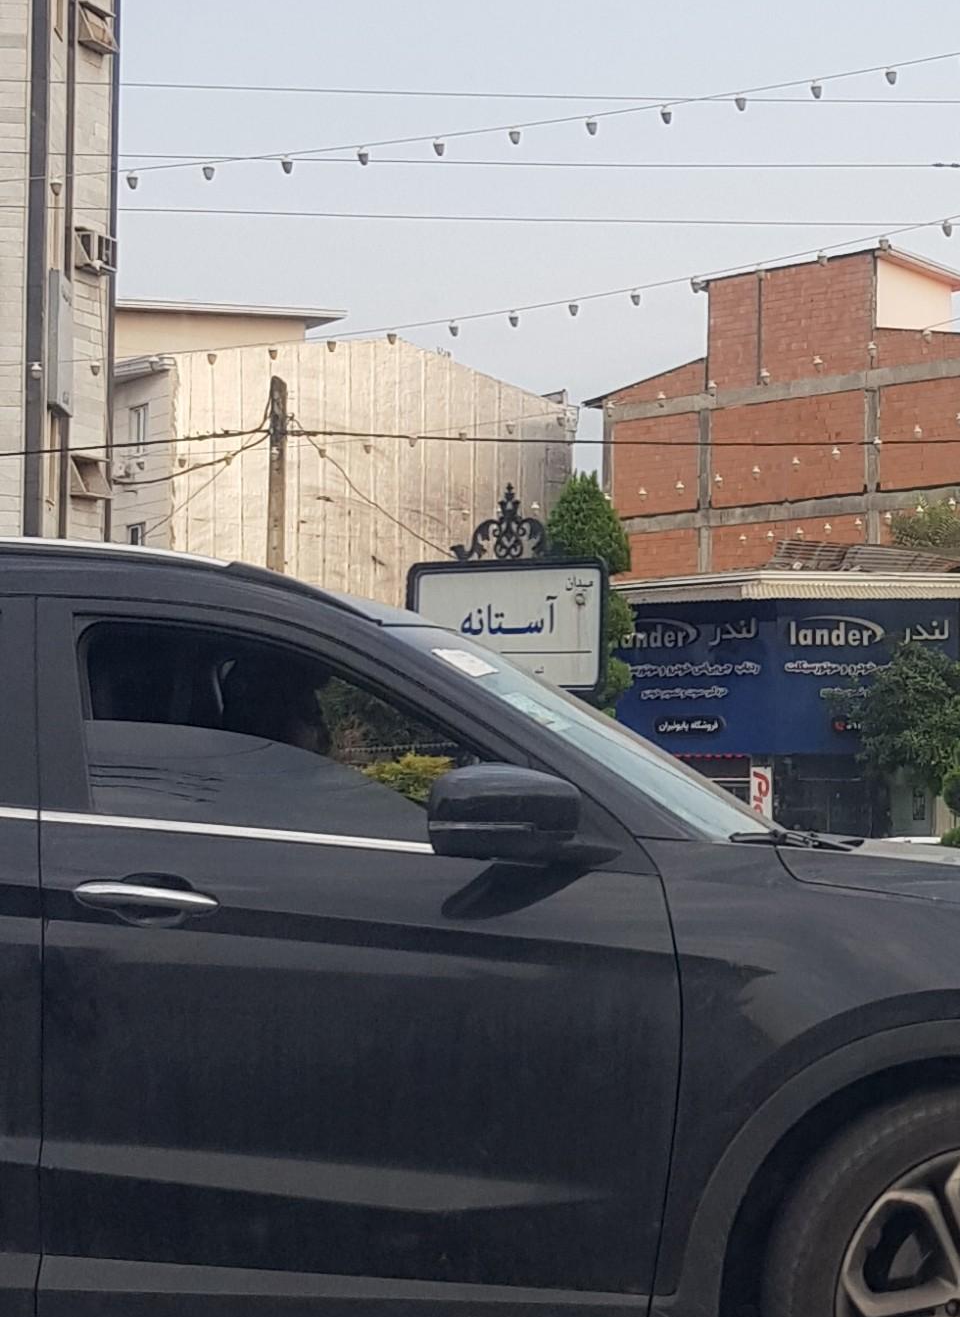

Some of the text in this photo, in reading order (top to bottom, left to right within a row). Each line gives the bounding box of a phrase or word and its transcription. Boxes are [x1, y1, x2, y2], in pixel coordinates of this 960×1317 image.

[565, 575, 594, 592] میدان
[460, 595, 558, 635] آستانه
[709, 617, 757, 646] لندر
[789, 621, 873, 646] lander
[899, 619, 949, 645] لندر
